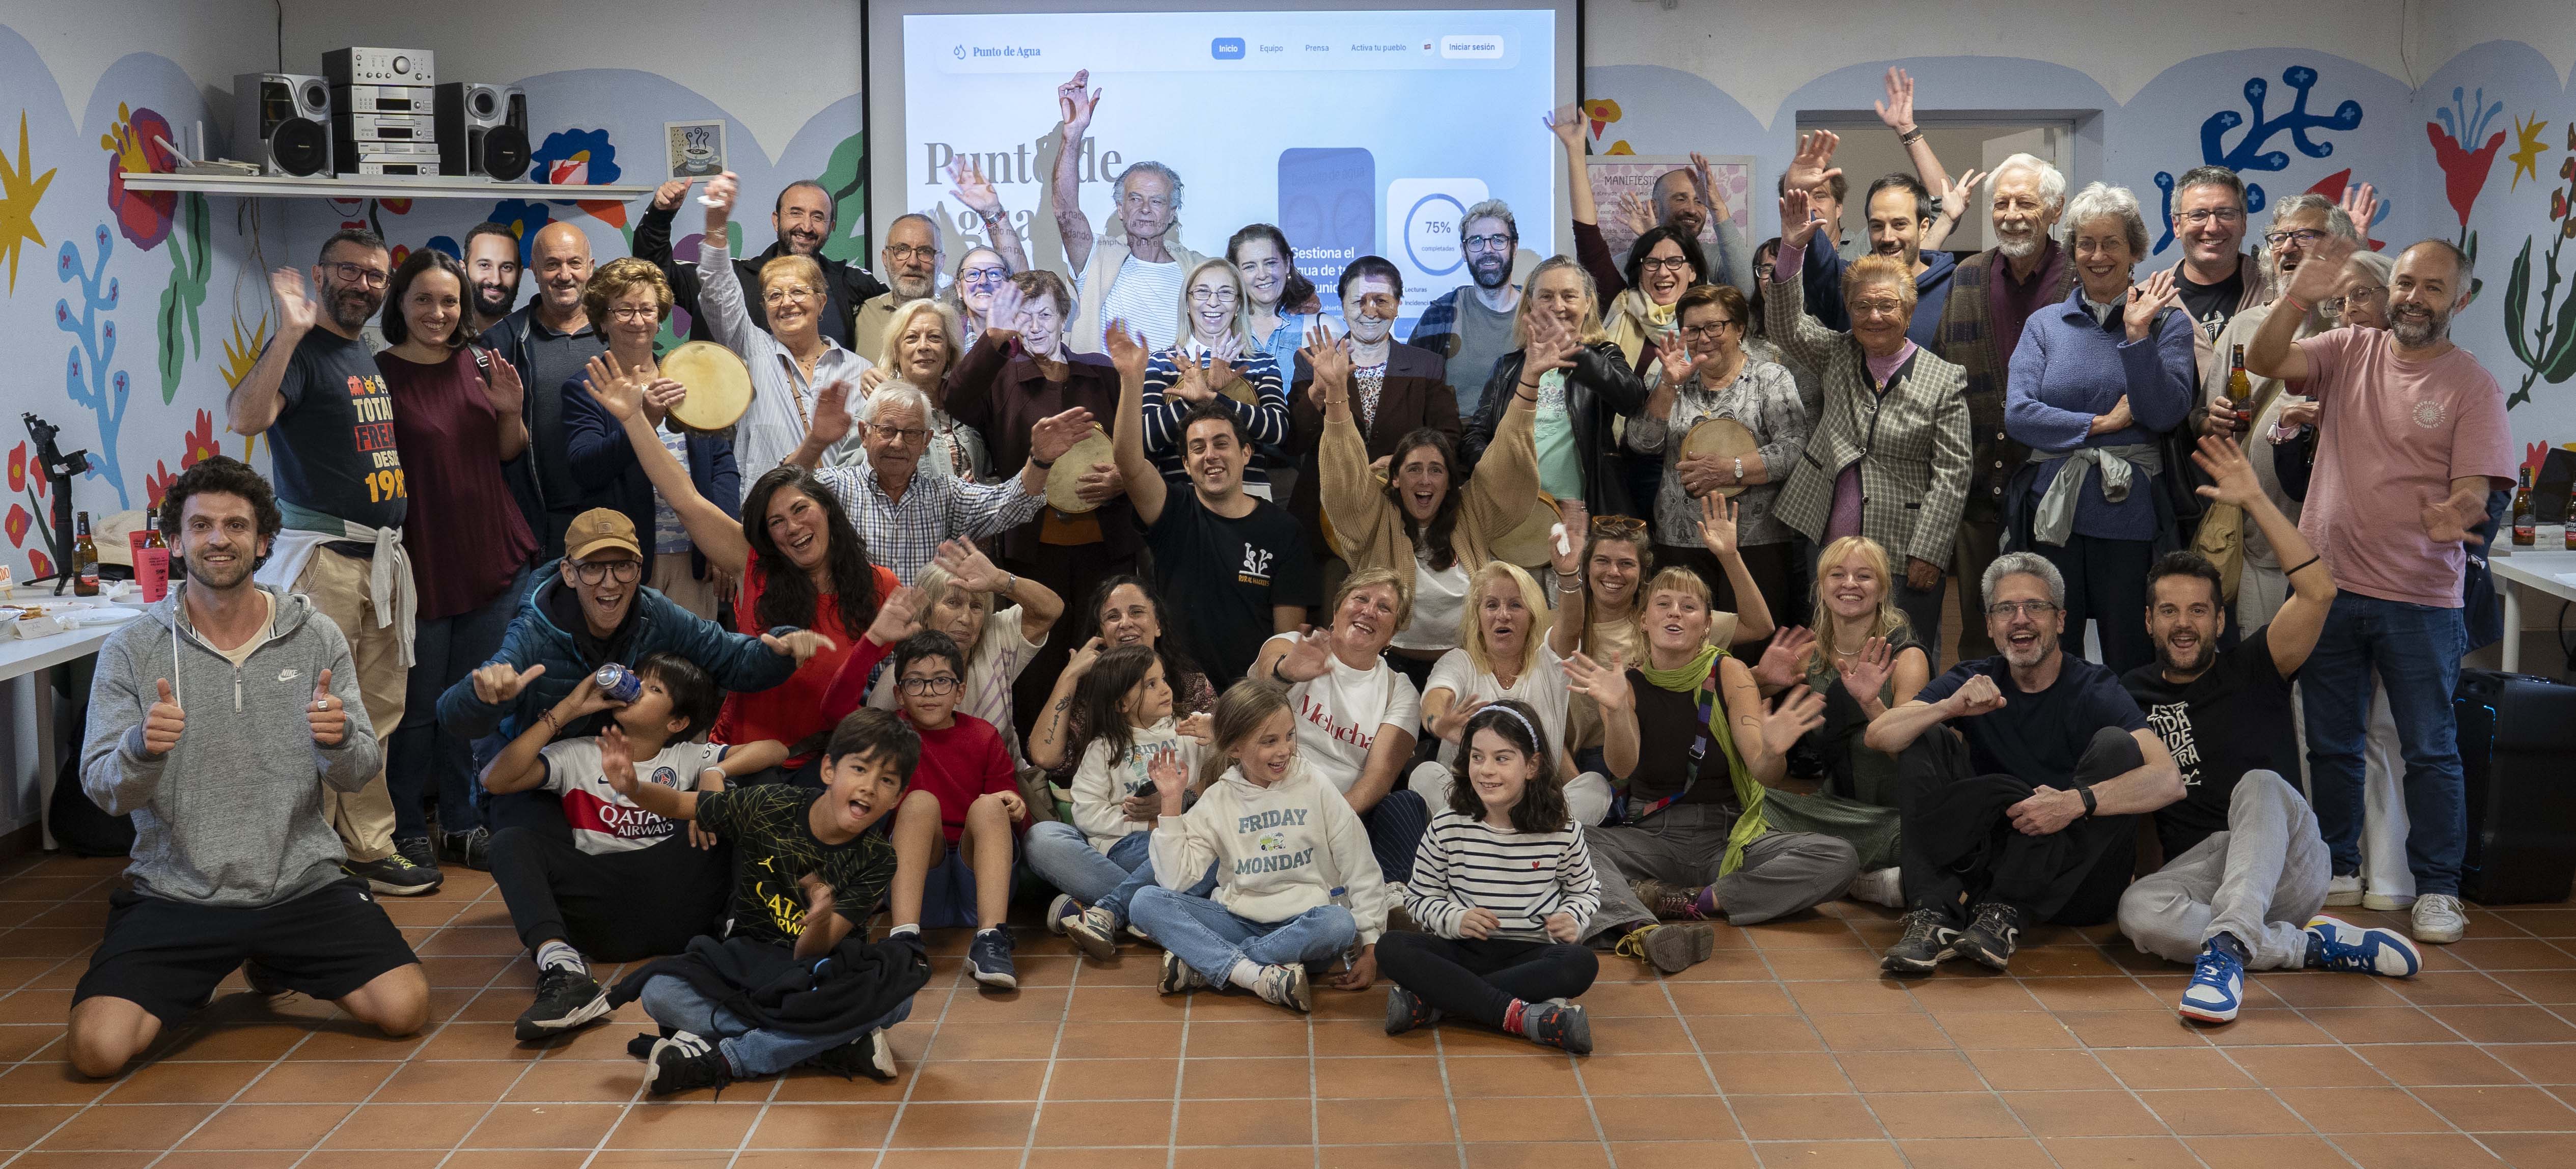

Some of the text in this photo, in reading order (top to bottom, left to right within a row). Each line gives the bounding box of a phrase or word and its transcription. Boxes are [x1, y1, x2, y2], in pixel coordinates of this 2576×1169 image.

[973, 45, 1040, 58] Punto de Agua
[1219, 44, 1238, 52] Inicio
[1260, 44, 1283, 53] Equipo
[1383, 44, 1406, 52] pueblo
[1472, 42, 1495, 50] sesión
[1425, 221, 1451, 234] 75%
[1344, 246, 1354, 259] el
[1321, 264, 1336, 276] de
[365, 467, 407, 503] 198
[281, 669, 298, 677] NIKE
[655, 768, 669, 778] PARIS
[599, 805, 672, 828] QATA
[1238, 809, 1308, 834] FRIDAY
[617, 820, 674, 837] AIRWAYS
[1235, 847, 1314, 875] MONDAY
